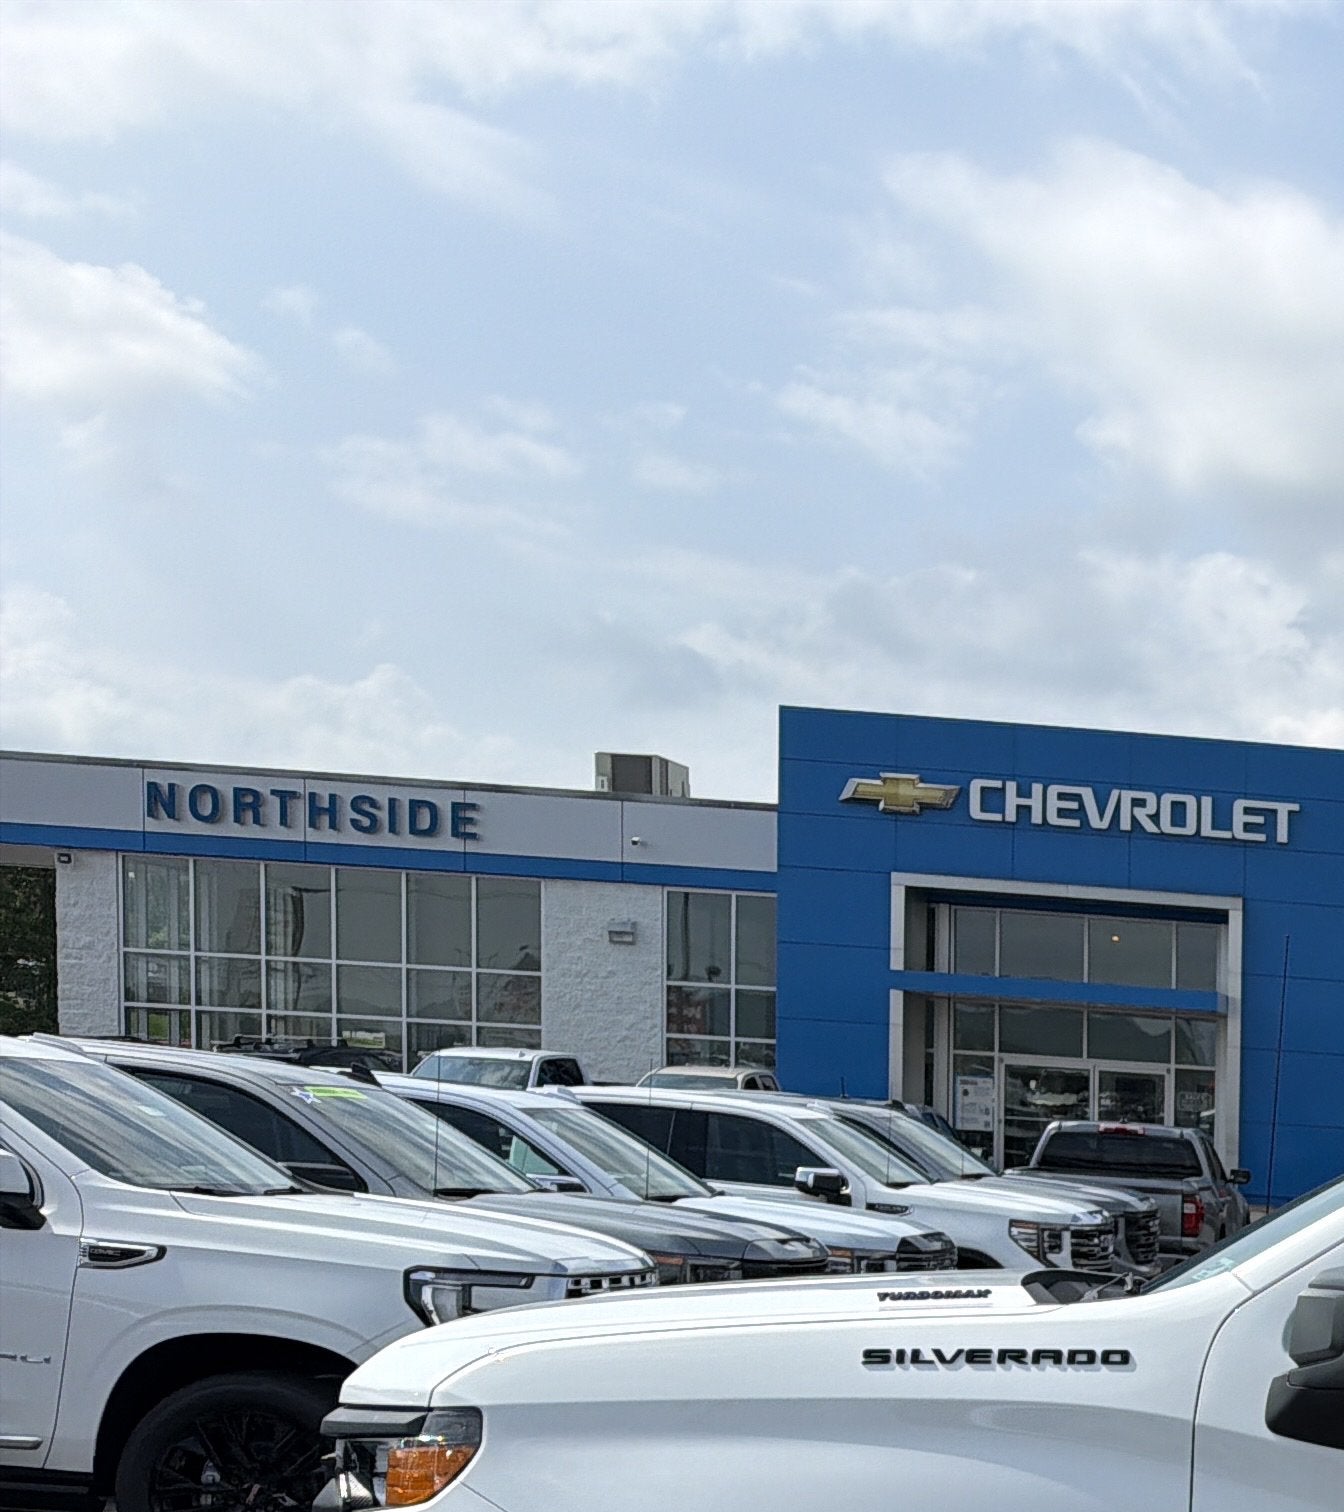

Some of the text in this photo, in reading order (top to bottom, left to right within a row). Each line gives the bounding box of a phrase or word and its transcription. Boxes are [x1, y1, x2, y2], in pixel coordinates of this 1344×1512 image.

[146, 780, 480, 840] NORTHSIDE
[968, 778, 1300, 843] CHEVROLET
[861, 1348, 1132, 1366] SILVERADO
